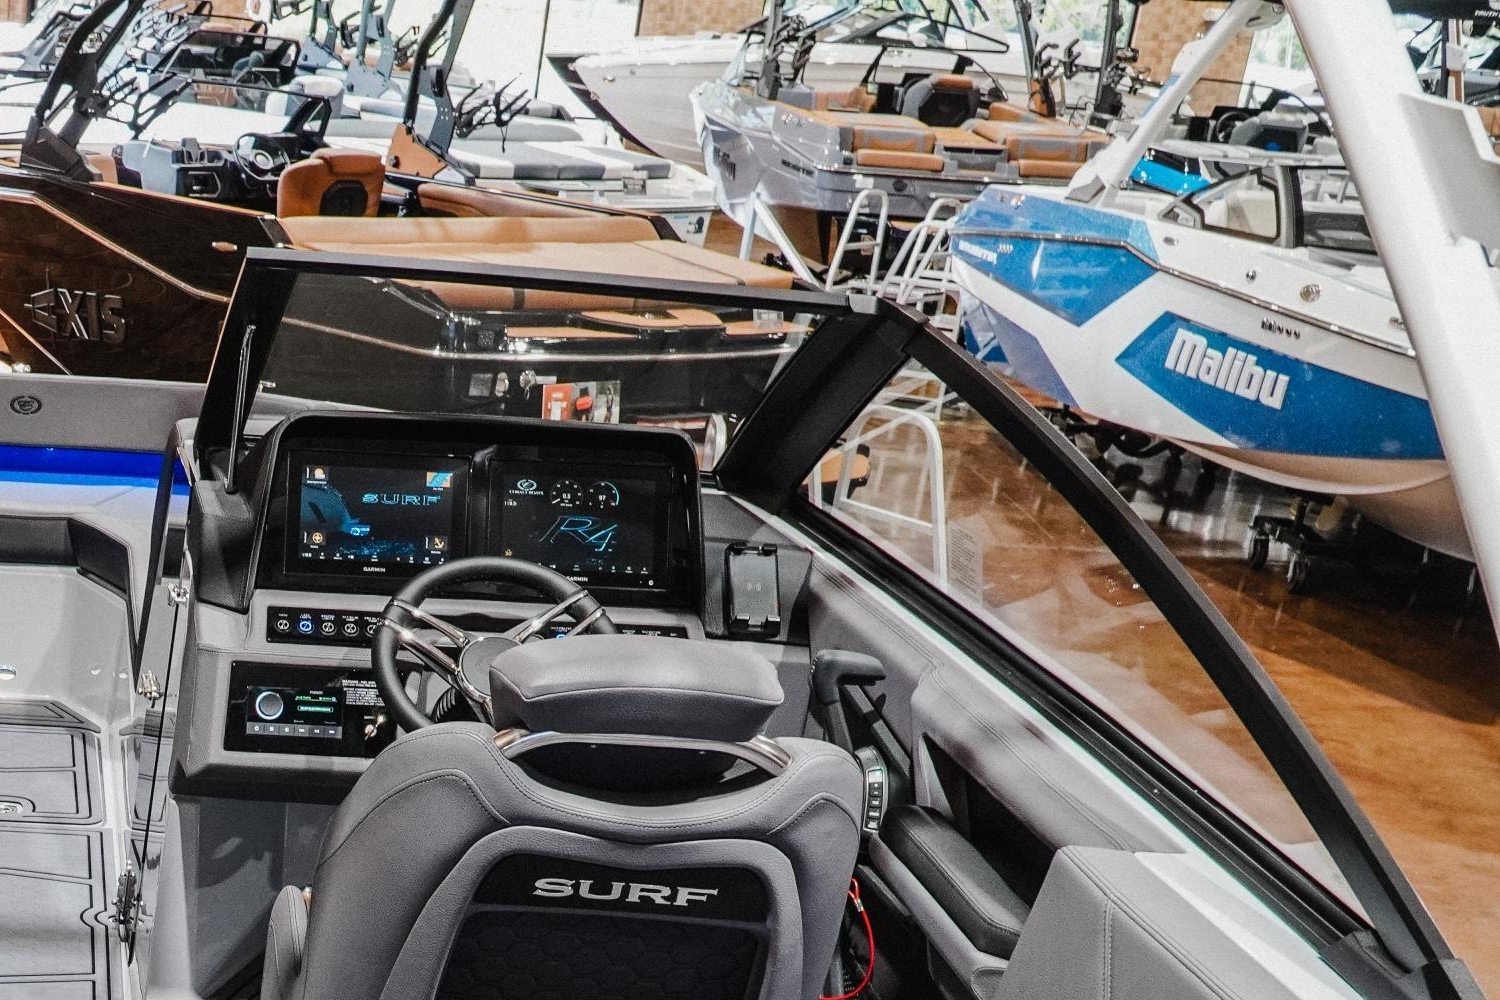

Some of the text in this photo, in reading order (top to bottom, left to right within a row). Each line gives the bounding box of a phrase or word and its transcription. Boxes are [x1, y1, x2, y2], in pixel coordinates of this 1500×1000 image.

[1164, 327, 1290, 410] Malibu
[361, 493, 441, 506] SURF
[533, 877, 719, 907] SURF
